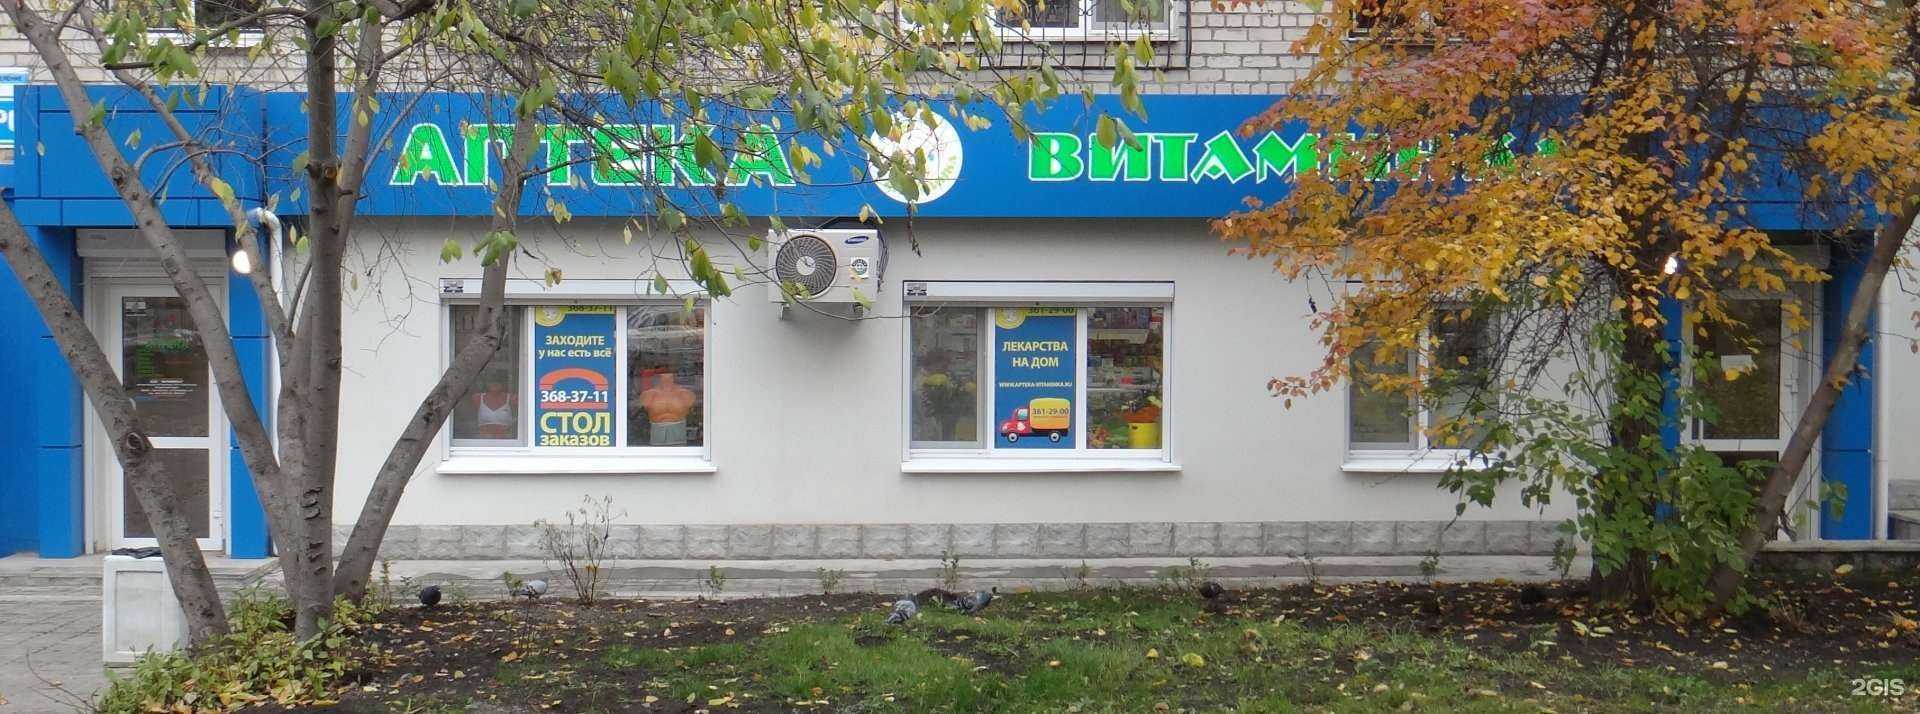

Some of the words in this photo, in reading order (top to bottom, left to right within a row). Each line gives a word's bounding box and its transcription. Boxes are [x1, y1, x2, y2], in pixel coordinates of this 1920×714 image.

[389, 122, 797, 187] АПТЕКА
[545, 335, 605, 347] ЗАХОДИТЕ
[1002, 341, 1069, 352] ЛЕКАРСТВА
[539, 350, 545, 359] у
[593, 348, 612, 357] всё
[1012, 357, 1029, 368] НА
[1030, 357, 1059, 369] ДОМ
[541, 390, 609, 403] 368-37-11
[1032, 408, 1070, 416] 361-29-00
[540, 412, 611, 434] СТОЛ
[540, 434, 611, 446] заказов
